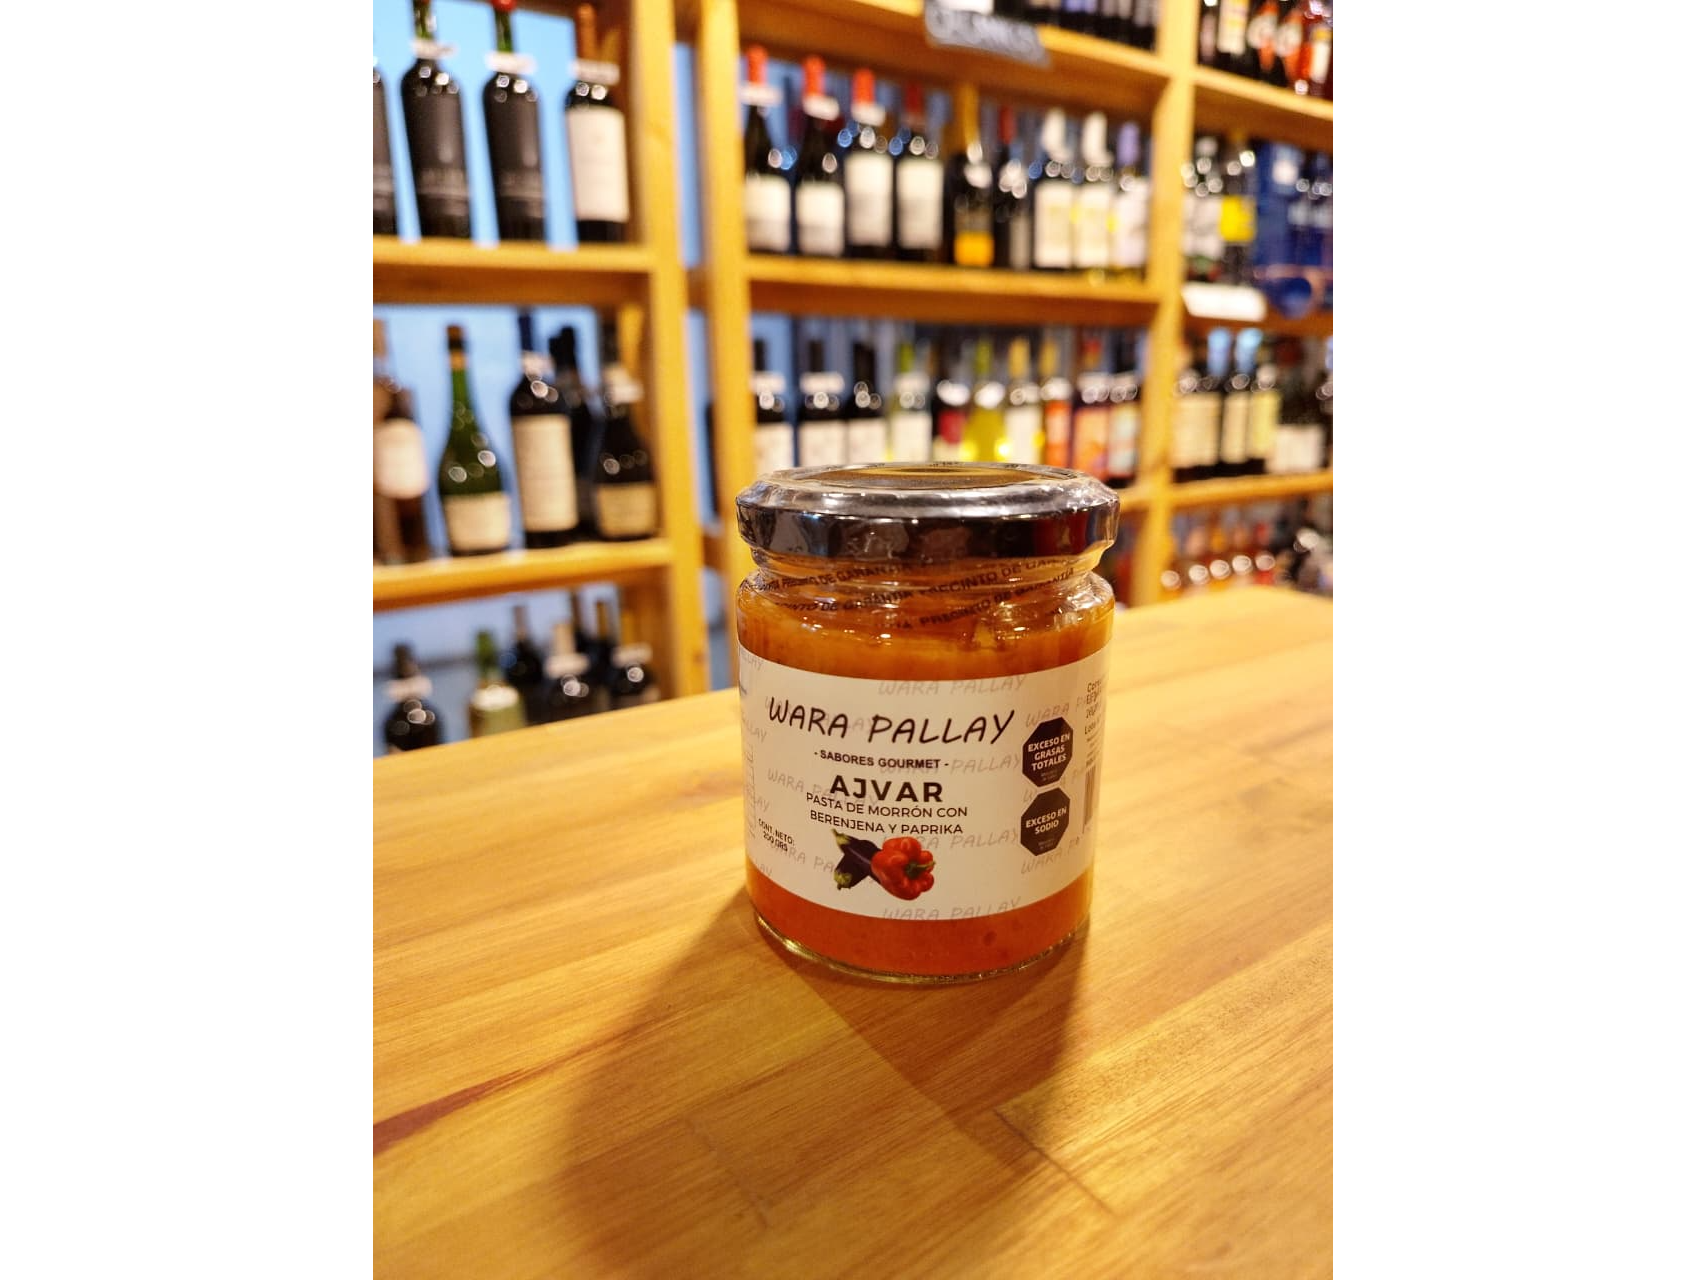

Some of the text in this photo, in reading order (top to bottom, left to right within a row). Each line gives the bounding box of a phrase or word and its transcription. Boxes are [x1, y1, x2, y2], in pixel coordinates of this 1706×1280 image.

[768, 696, 849, 739] WARA
[867, 709, 1015, 744] PALLAY
[1027, 732, 1071, 752] EXCESO EN
[1034, 744, 1065, 761] GRASAS
[820, 750, 875, 767] SABORES
[878, 757, 941, 769] GOURMET
[1031, 753, 1067, 772] TOTALES
[830, 775, 943, 802] AJVAR
[806, 792, 968, 818] PASTA DE MORRÓN CON
[810, 809, 963, 835] BERENJENA Y PAPRIKA
[1025, 806, 1067, 828] EXCESO EN
[1034, 819, 1060, 835] SODIO
